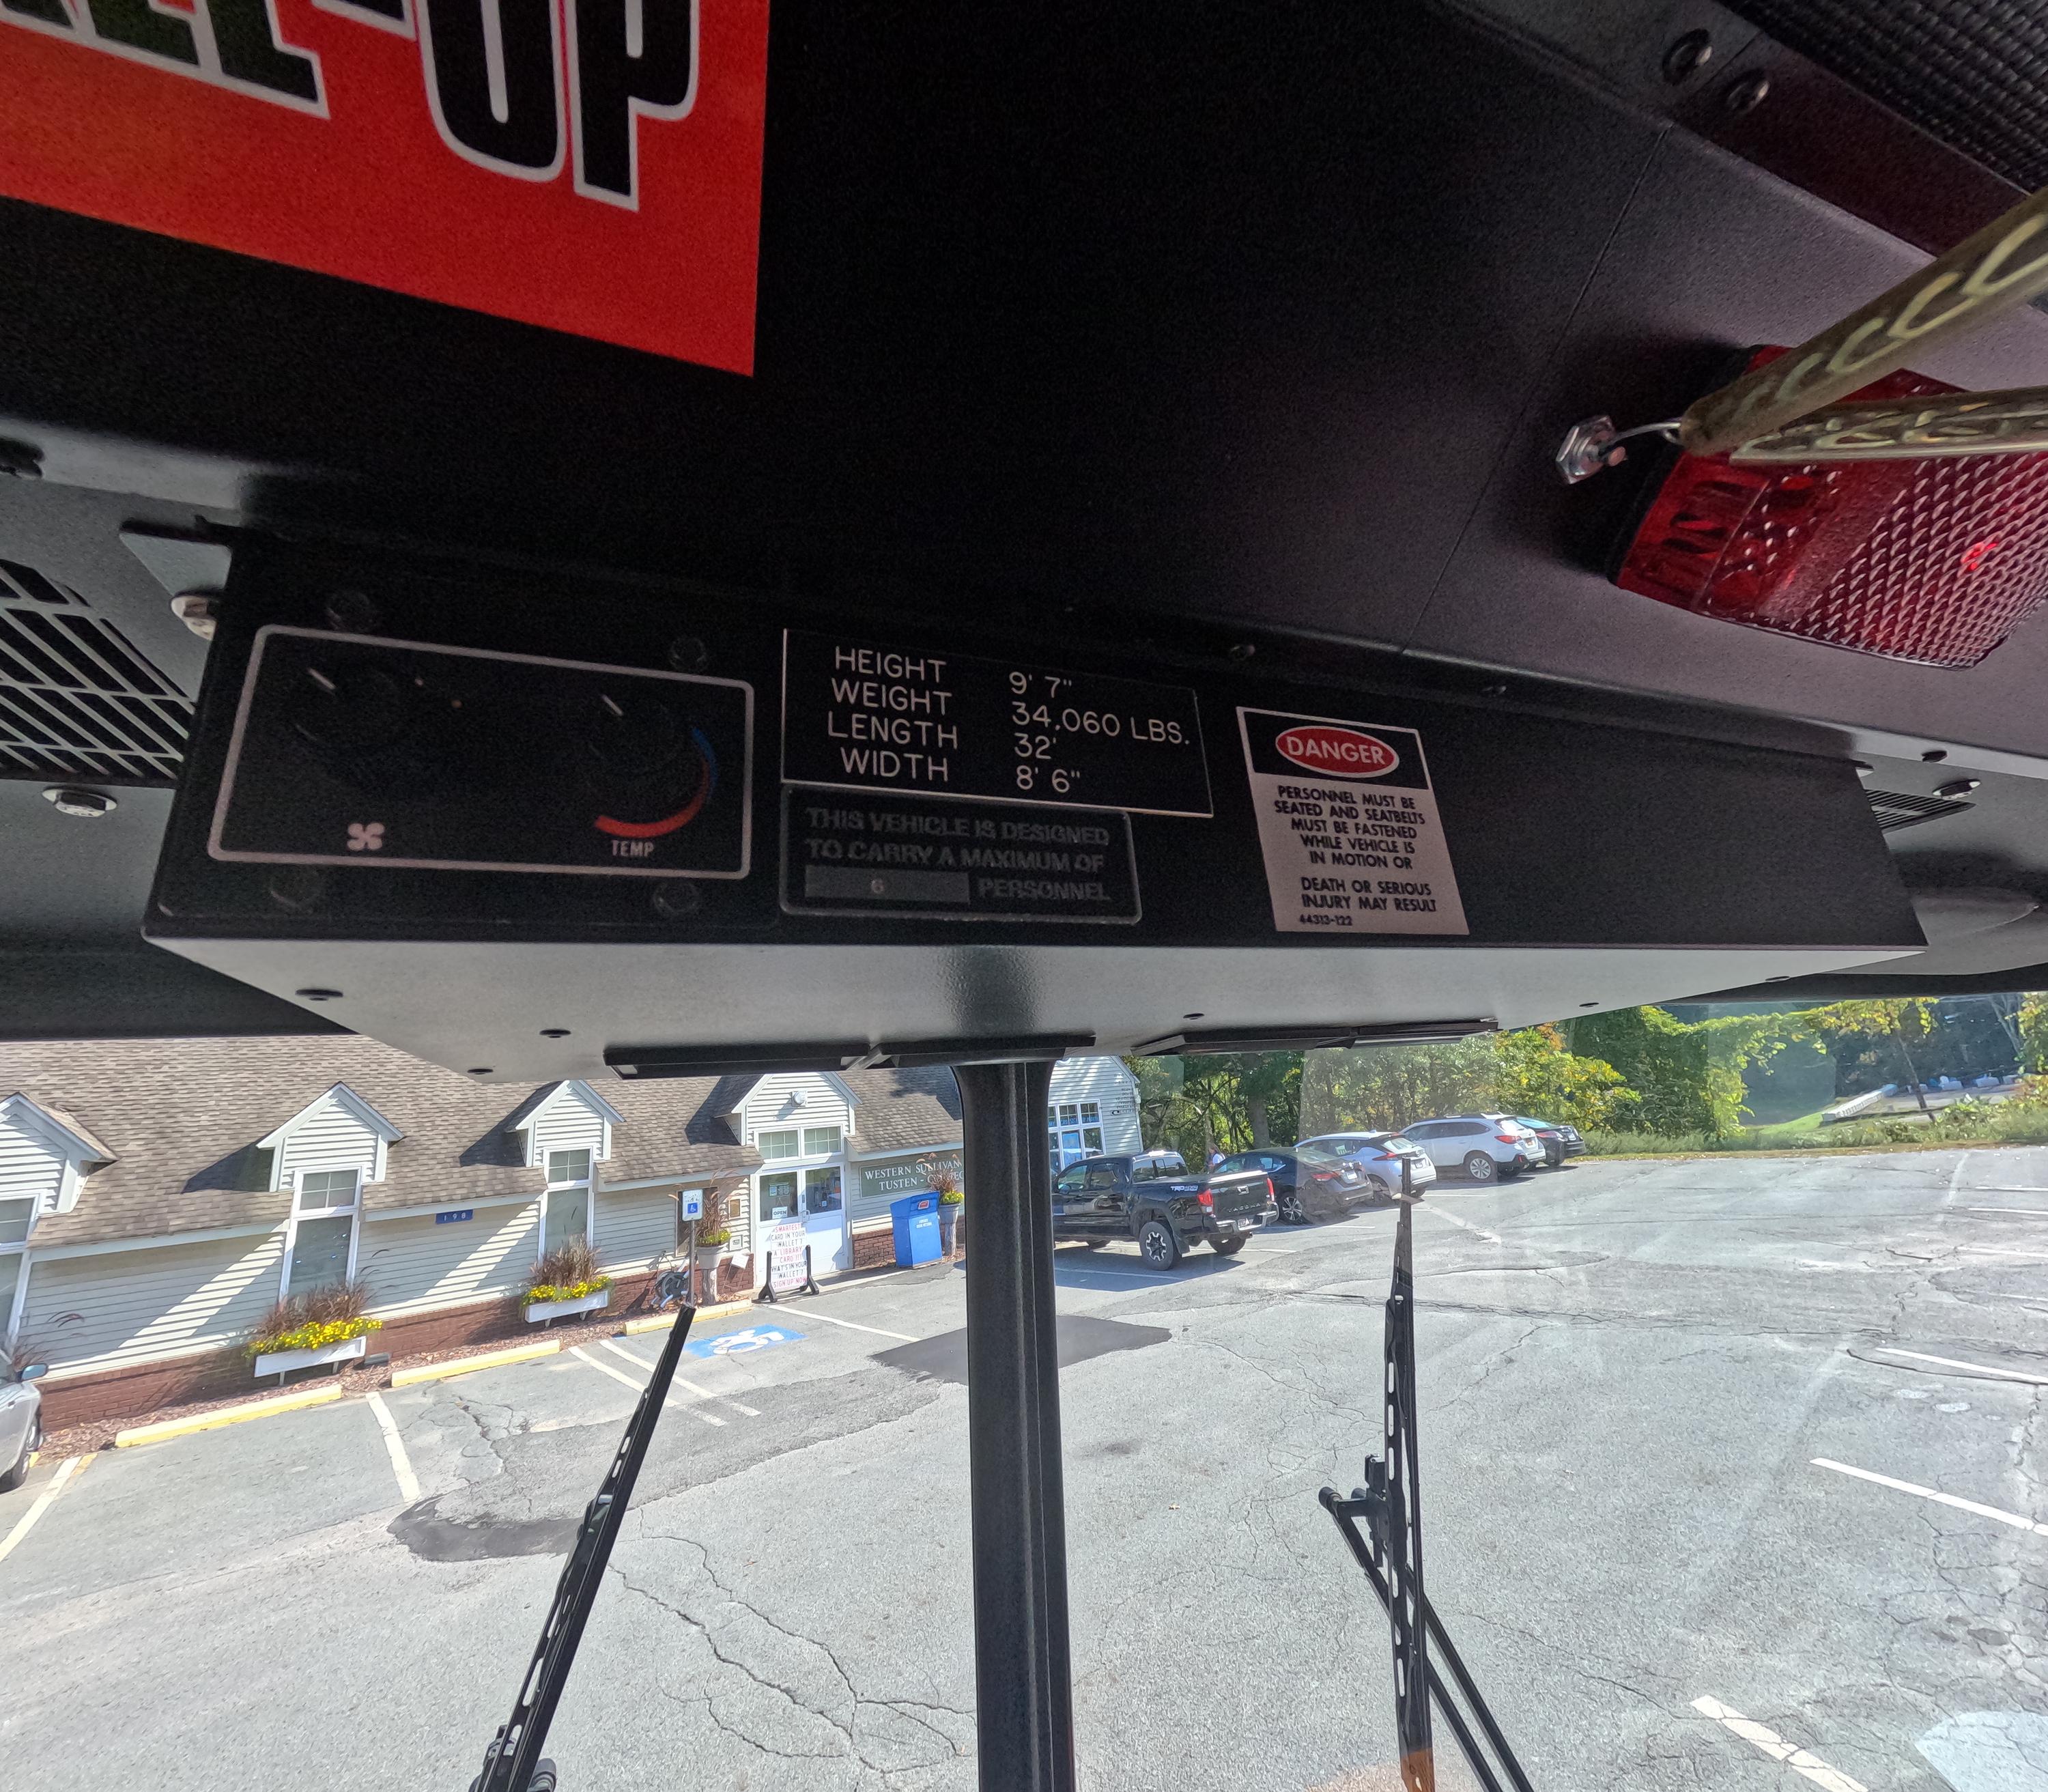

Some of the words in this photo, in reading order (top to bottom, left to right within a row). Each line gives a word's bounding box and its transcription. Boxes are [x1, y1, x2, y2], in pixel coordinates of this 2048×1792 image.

[835, 646, 947, 683] HEIGHT
[1009, 671, 1032, 694] 9'
[1044, 676, 1072, 698] 7"
[831, 677, 952, 715] WEIGHT
[827, 711, 957, 750] LENGTH
[1130, 717, 1189, 745] LBS.
[1014, 732, 1056, 759] 32'
[1286, 736, 1386, 765] DANGER
[840, 747, 948, 782] WIDTH
[1016, 765, 1038, 790] 8'
[1051, 769, 1080, 793] 6"
[1277, 785, 1357, 804] PERSONNEL
[1362, 793, 1395, 808] MUST
[1401, 797, 1416, 810] BE
[1274, 800, 1323, 816] SEATED
[1330, 806, 1359, 819] AND
[1365, 808, 1425, 825] SEATBELTS
[806, 807, 865, 830] THIS
[868, 812, 971, 837] VEHICLE
[976, 820, 996, 839] IS
[1001, 821, 1111, 846] DESIGNED
[1291, 818, 1327, 832] MUST
[1333, 821, 1349, 834] BE
[1354, 823, 1417, 839] FASTENED
[611, 840, 654, 857] TEMP
[1300, 834, 1342, 849] WHILE
[1348, 838, 1399, 853] VEHICLE
[1404, 841, 1415, 854] IS
[804, 838, 843, 859] TO
[848, 841, 934, 864] CARRY
[937, 845, 955, 866] A
[959, 848, 1071, 872] MAXIMUM
[1073, 853, 1104, 873] OF
[1309, 851, 1326, 864] IN
[1332, 852, 1388, 868] MOTION
[1393, 856, 1412, 869] OR
[978, 878, 1111, 900] PERSONNEL
[1300, 877, 1346, 892] DEATH
[1351, 880, 1372, 893] OR
[1378, 881, 1432, 896] SERIOUS
[1301, 894, 1351, 909] INJURY
[1359, 896, 1387, 910] MAY
[1394, 898, 1436, 912] RESULT
[864, 1165, 911, 1180] WESTERN
[879, 1177, 918, 1191] TUSTEN
[444, 1212, 466, 1221] 198
[775, 1223, 801, 1233] SMARTEST
[792, 1229, 806, 1238] YOUR
[778, 1240, 798, 1248] WALLET
[780, 1246, 802, 1255] LIBRARY
[773, 1280, 785, 1288] SIGN
[787, 1279, 794, 1287] UP
[778, 1271, 799, 1279] WALLET
